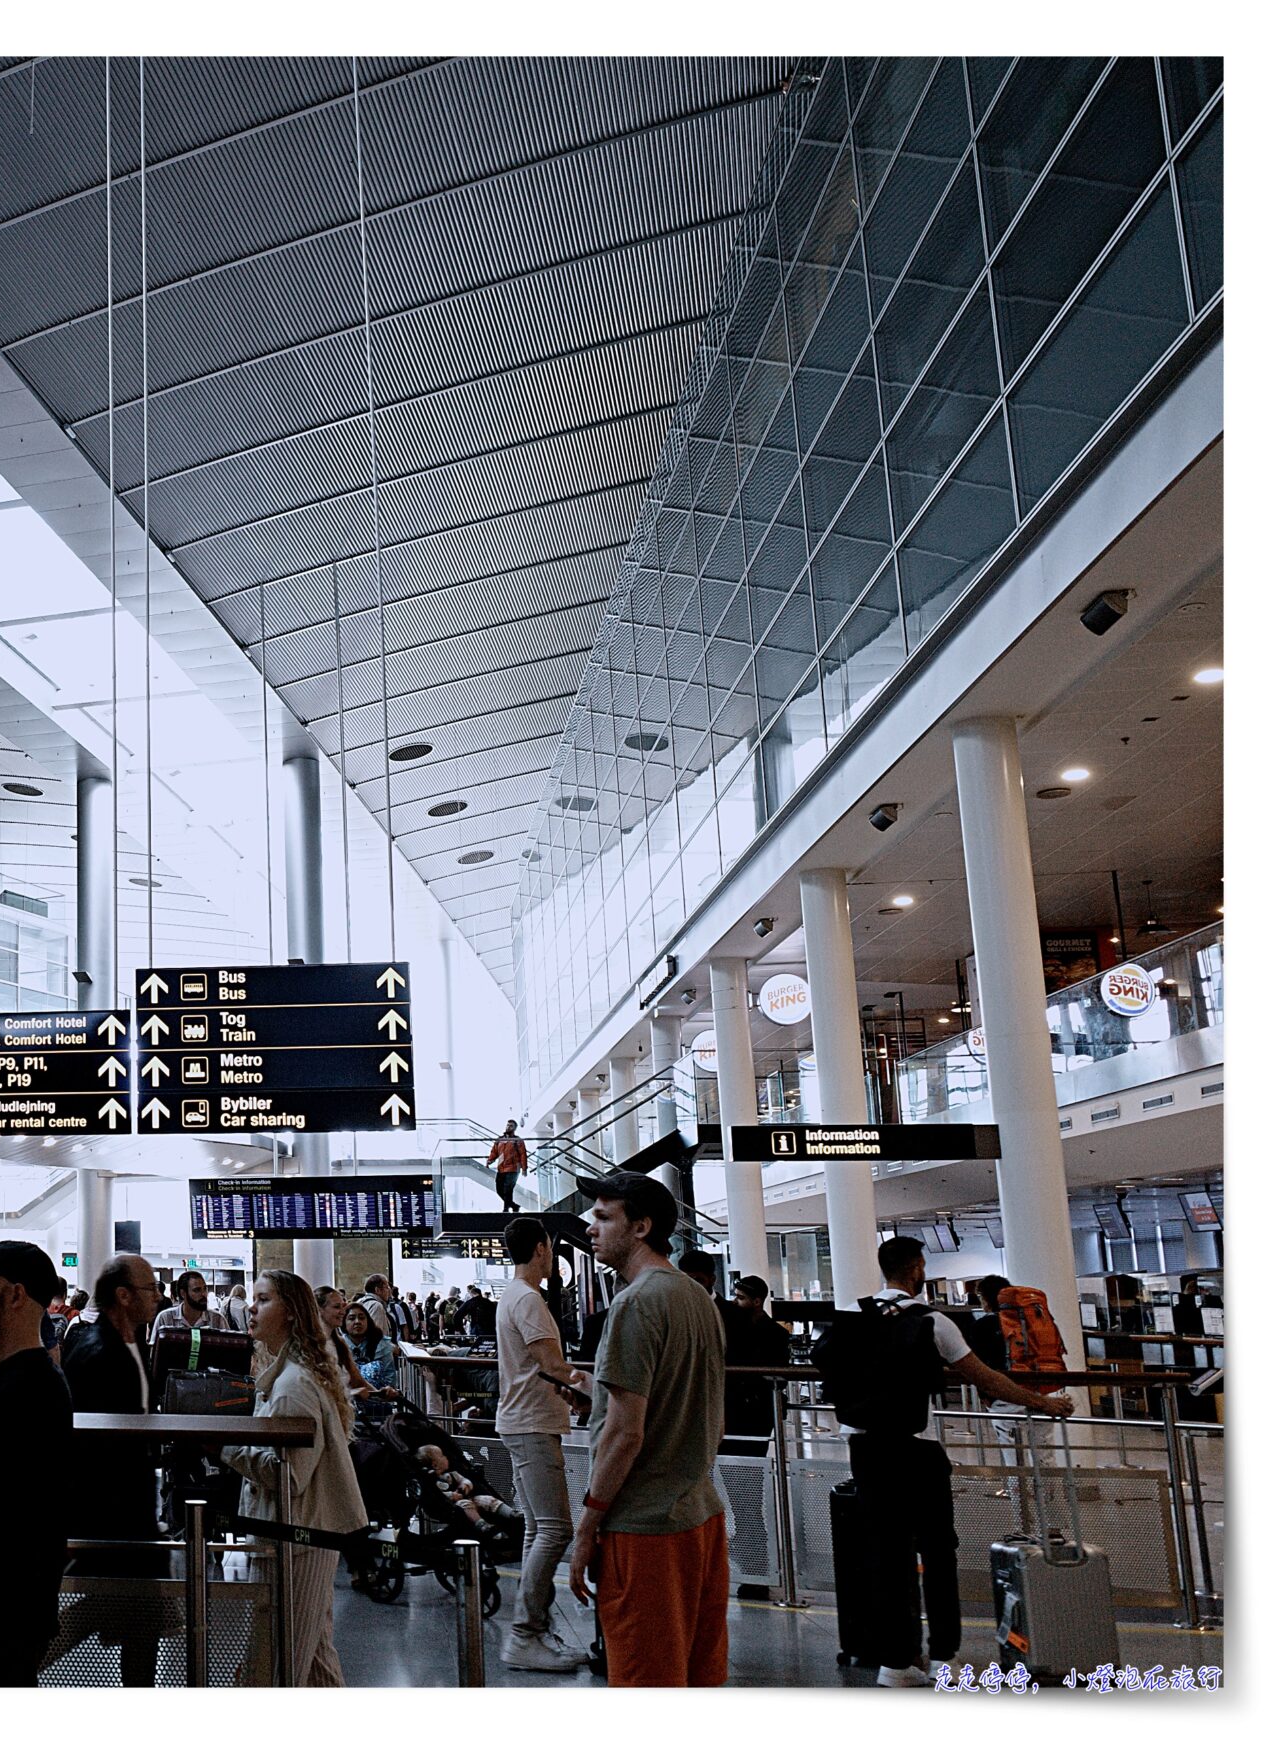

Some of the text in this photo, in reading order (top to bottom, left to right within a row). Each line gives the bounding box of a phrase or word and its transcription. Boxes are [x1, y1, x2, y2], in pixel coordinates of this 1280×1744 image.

[1046, 938, 1091, 946] GOURMET
[219, 971, 246, 983] Bus
[219, 987, 246, 1000] Bus
[767, 983, 804, 1000] BURGER
[770, 992, 806, 1012] KING
[4, 1018, 52, 1030] Comfort
[55, 1016, 86, 1028] Hotel
[220, 1012, 245, 1027] Tog
[4, 1034, 51, 1045] Comfort
[56, 1033, 86, 1044] Hotel
[220, 1028, 255, 1041] Train
[24, 1057, 47, 1071] P11,
[221, 1054, 262, 1066] Metro
[8, 1074, 31, 1086] P19
[221, 1071, 263, 1083] Metro
[221, 1097, 272, 1113] Bybiler
[11, 1117, 44, 1127] rental
[49, 1117, 87, 1127] centre
[221, 1113, 305, 1128] Car sharing
[805, 1129, 879, 1141] Information
[806, 1143, 880, 1154] Information
[294, 1528, 310, 1544] CPH
[381, 1543, 399, 1559] CPH
